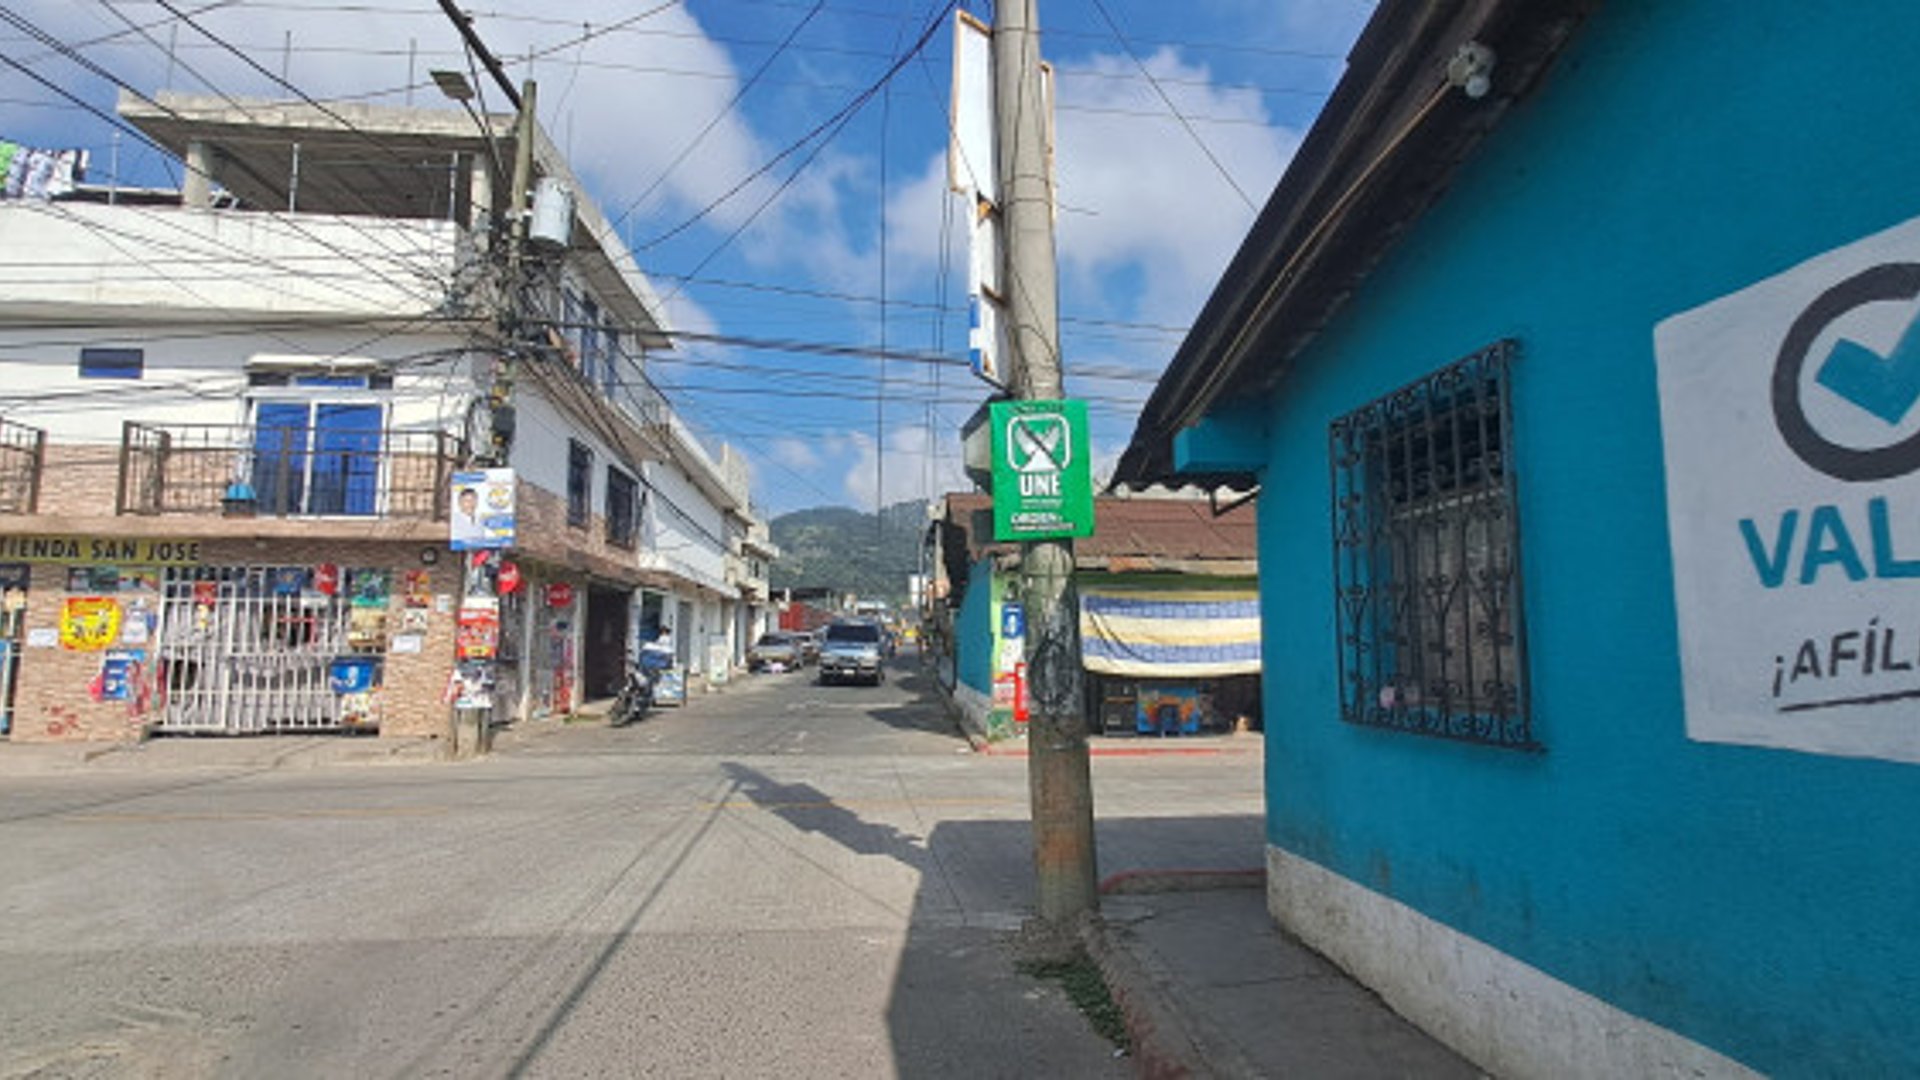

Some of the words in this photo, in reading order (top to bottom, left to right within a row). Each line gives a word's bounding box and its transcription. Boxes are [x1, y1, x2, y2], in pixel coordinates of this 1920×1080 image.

[1020, 475, 1061, 496] UNE
[92, 539, 138, 560] SAN
[146, 542, 200, 561] JOSE
[1738, 495, 1920, 588] VAL
[1772, 616, 1920, 697] ¡AFÍL
